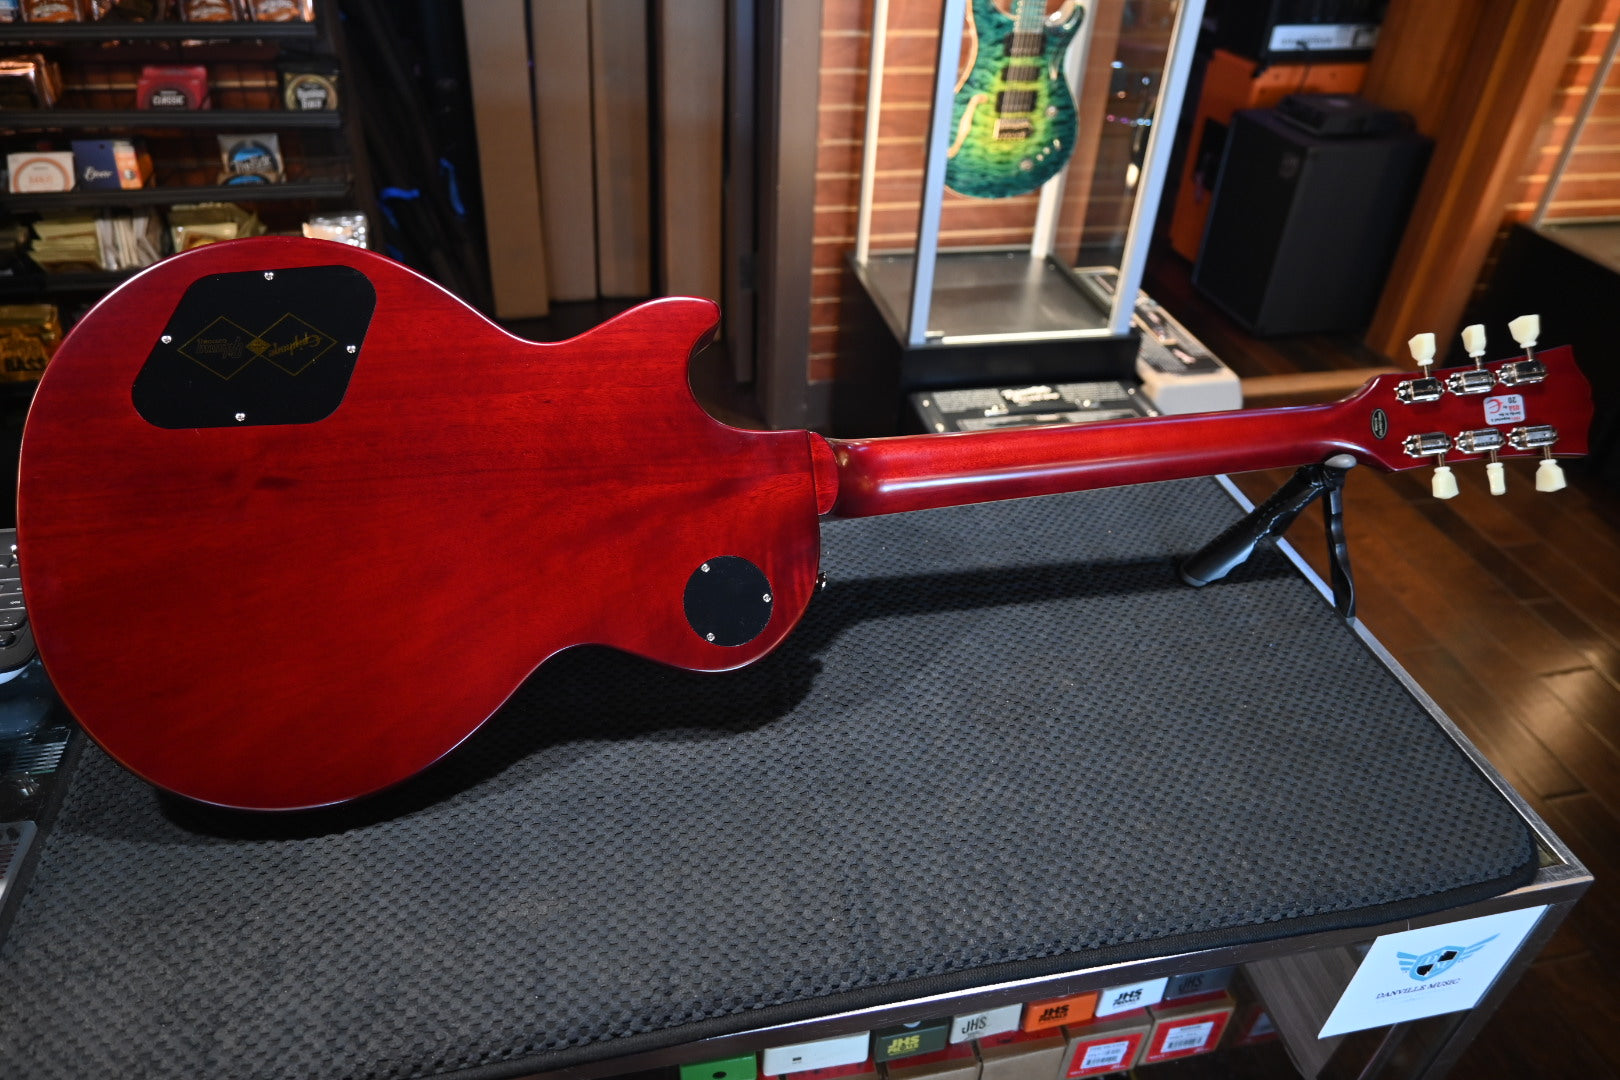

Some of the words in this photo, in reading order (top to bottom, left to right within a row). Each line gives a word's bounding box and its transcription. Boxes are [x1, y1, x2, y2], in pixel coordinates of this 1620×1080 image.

[1427, 978, 1461, 989] MUSIC
[1115, 988, 1143, 1002] JHS
[1040, 1005, 1069, 1018] JHS
[962, 1016, 987, 1034] JHS
[887, 1035, 920, 1050] JHS
